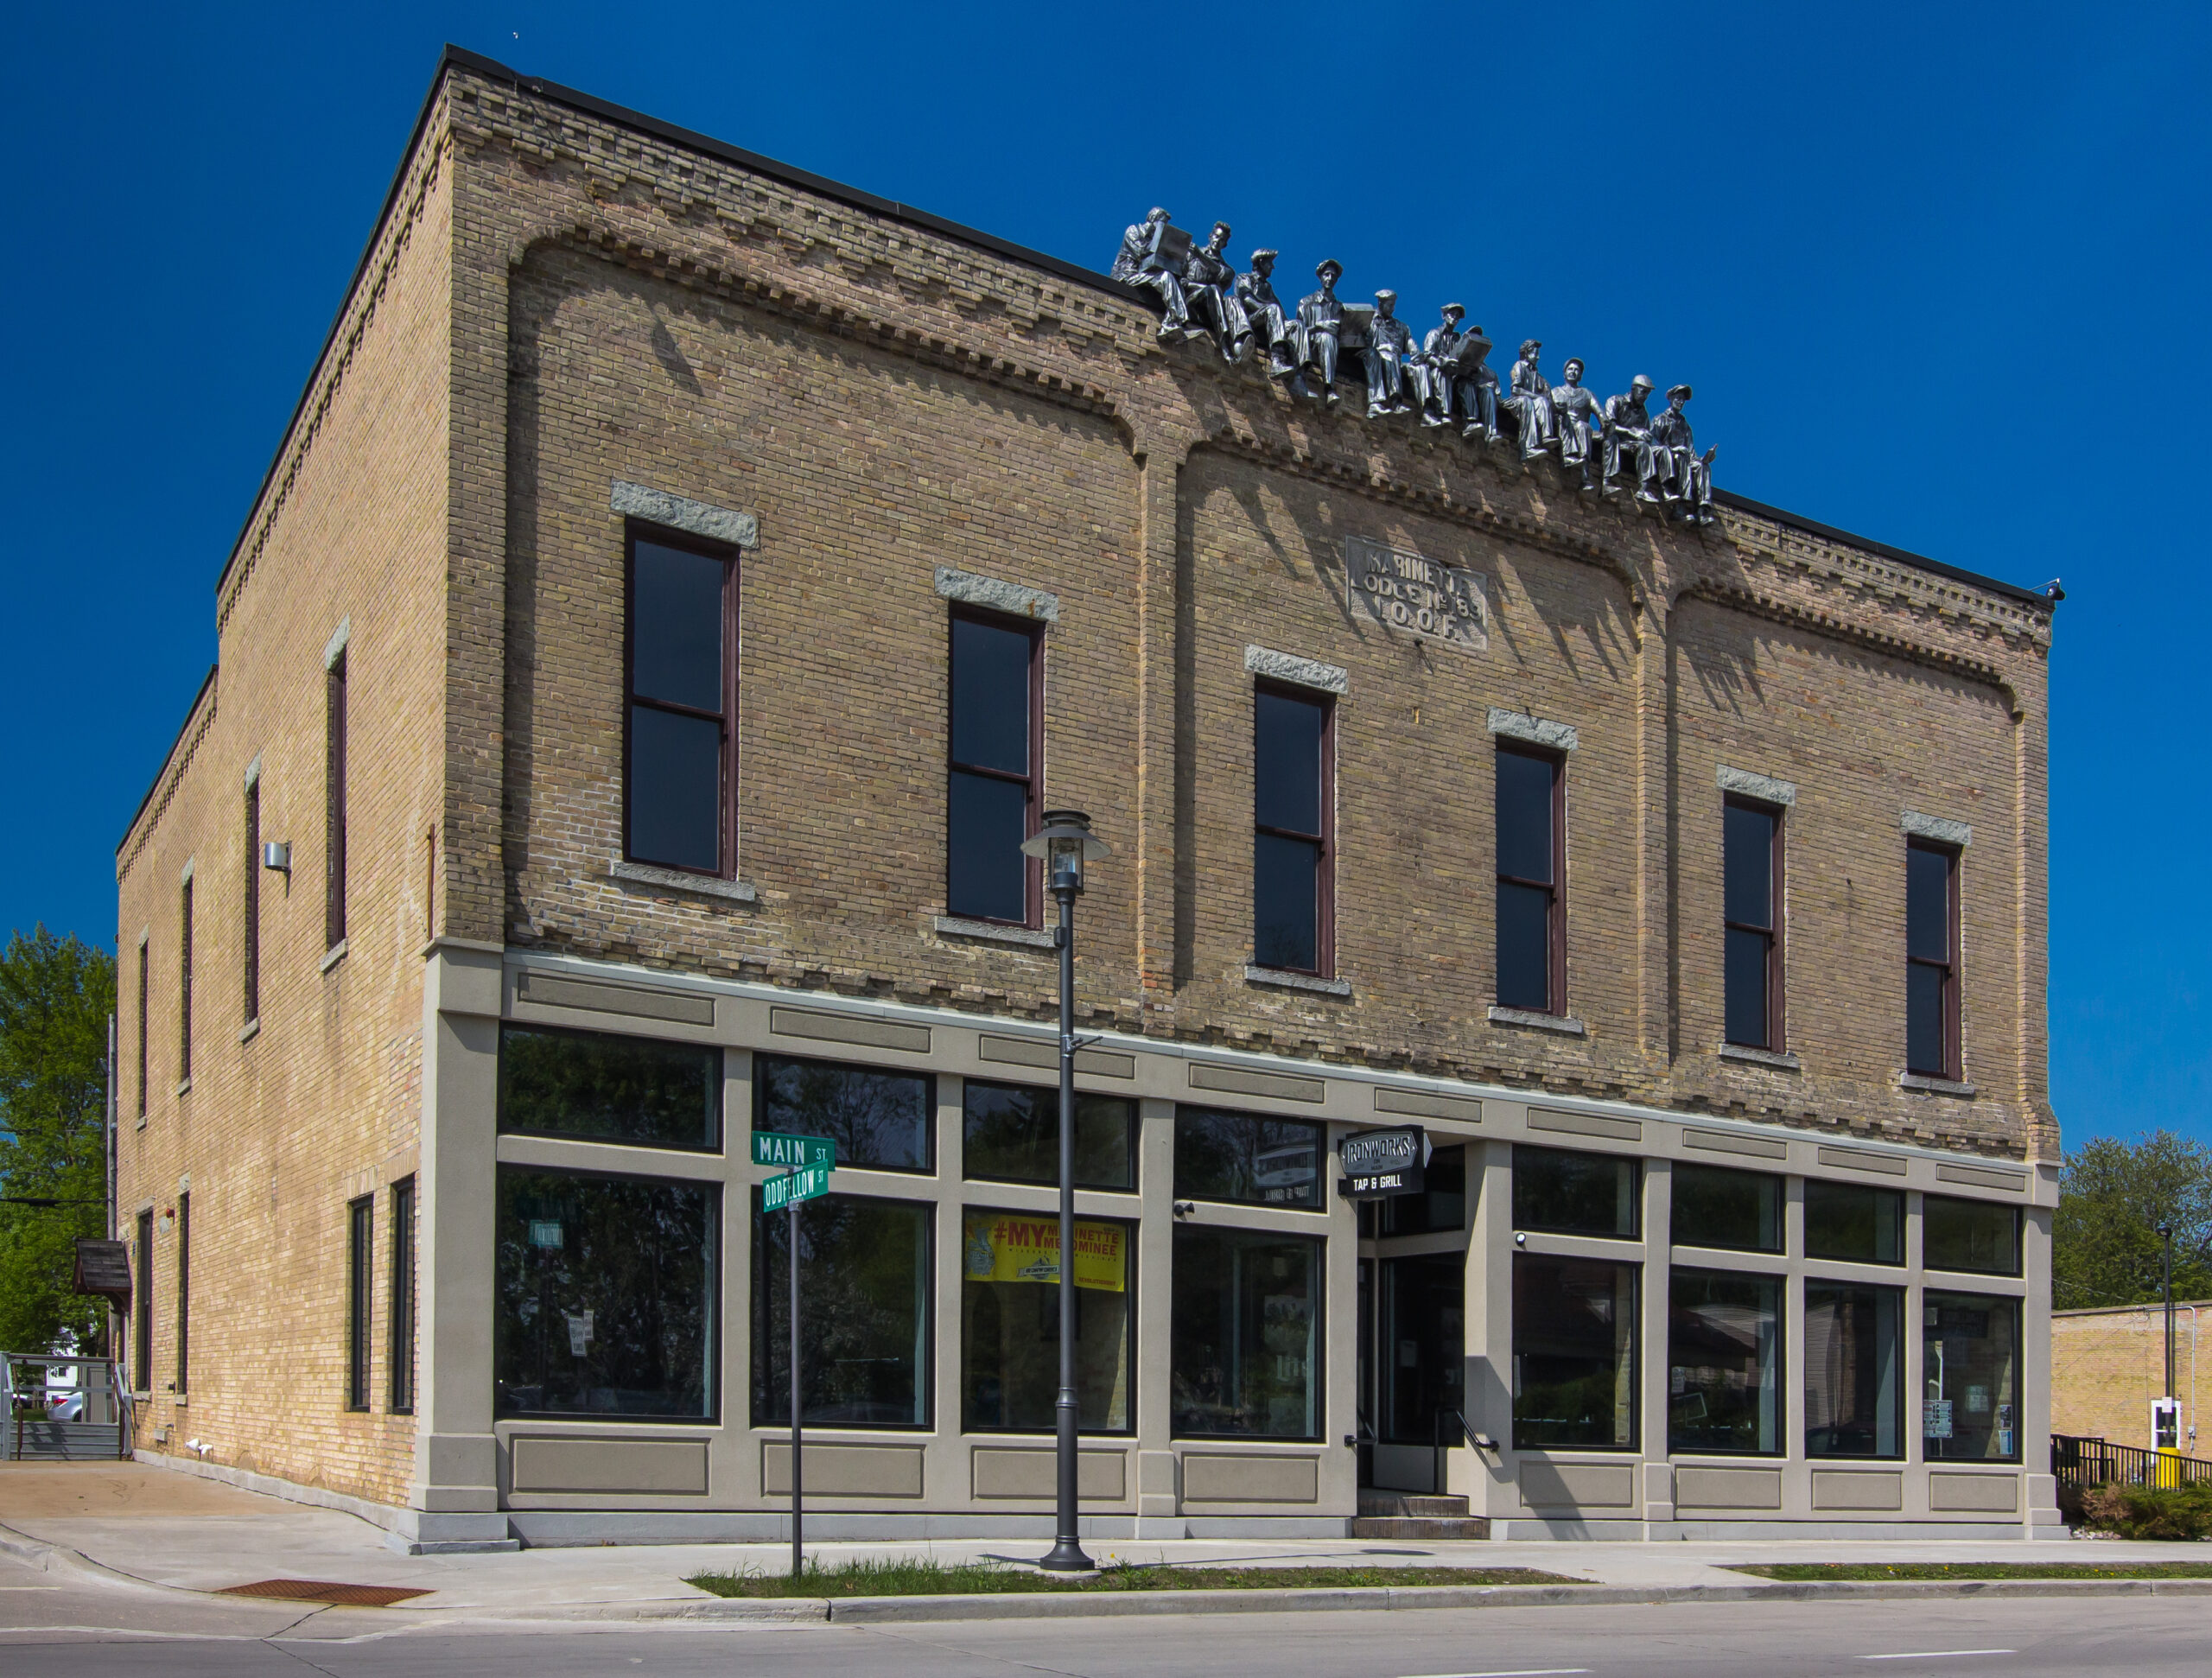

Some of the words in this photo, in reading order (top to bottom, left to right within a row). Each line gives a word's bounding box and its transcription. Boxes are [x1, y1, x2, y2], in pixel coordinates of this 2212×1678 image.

[1367, 551, 1468, 597] MARINETTE
[760, 1136, 804, 1164] MAIN
[816, 1147, 826, 1160] ST
[1347, 1136, 1410, 1164] IRONWORKS
[766, 1169, 815, 1206] ODDFELLOW
[818, 1170, 823, 1183] ST
[1353, 1178, 1369, 1191] TAP
[1371, 1178, 1377, 1189] &
[1380, 1175, 1402, 1188] GRILL
[995, 1220, 1046, 1248] #MY
[1048, 1224, 1119, 1244] MINETTE
[1044, 1237, 1116, 1256] MEOMINEE
